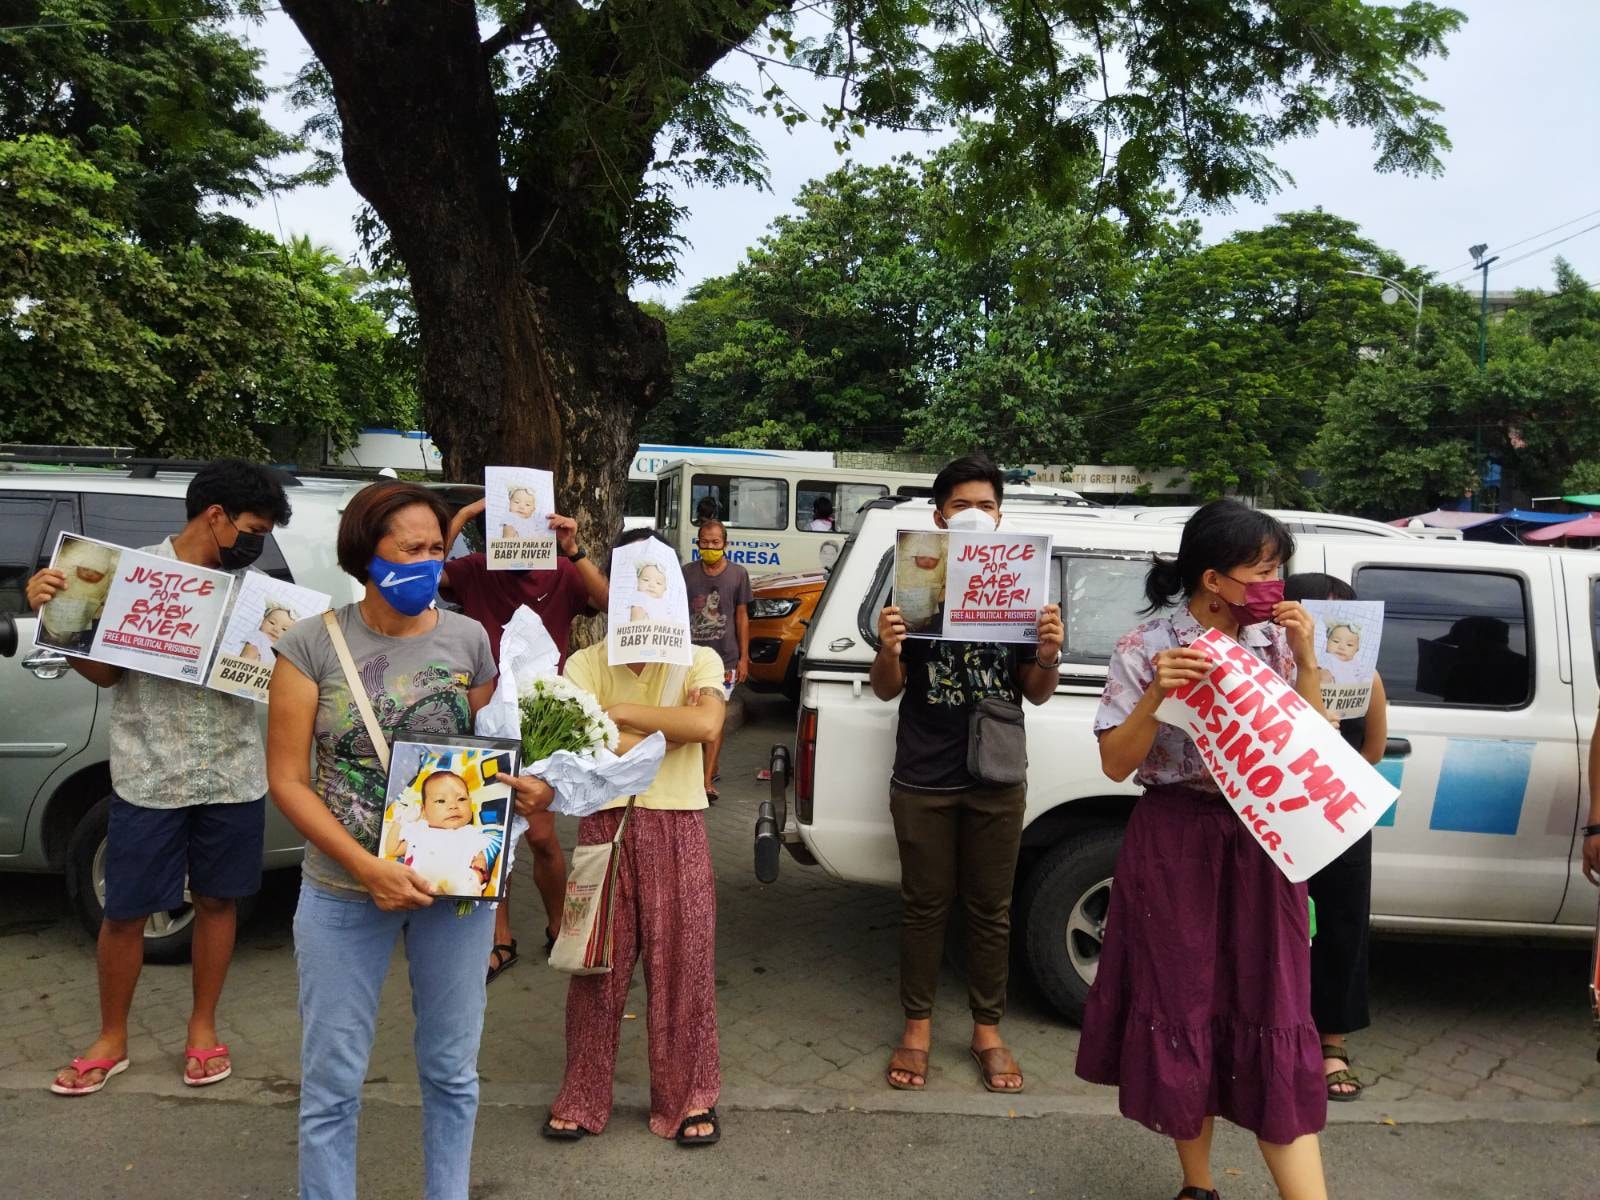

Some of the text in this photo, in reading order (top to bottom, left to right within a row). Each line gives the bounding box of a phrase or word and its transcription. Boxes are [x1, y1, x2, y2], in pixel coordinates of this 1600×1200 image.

[1090, 474, 1117, 484] GREEN
[491, 541, 520, 549] HUSTISYA
[494, 549, 551, 559] BABY RIVER!
[957, 544, 1036, 563] JUSTICE
[982, 561, 1008, 575] FOR
[125, 566, 215, 596] JUSTICE
[968, 572, 1021, 589] BABY
[150, 590, 180, 603] FOR
[961, 588, 1031, 608] RIVER!
[131, 599, 193, 620] BABY
[950, 611, 964, 620] FREE
[965, 611, 975, 620] ALL
[976, 611, 1003, 620] POLITICAL
[616, 624, 685, 636] HUSTISYA PARA KAY
[103, 631, 121, 642] FREE
[119, 633, 132, 644] ALL
[132, 636, 163, 650] POLITICAL
[620, 634, 683, 648] BABY RIVER!
[220, 657, 271, 678] HUSTISYA PA
[1204, 629, 1307, 719] FREE
[220, 668, 253, 684] BABY
[1339, 689, 1356, 698] PARA
[1357, 687, 1370, 696] KAY
[1336, 697, 1366, 710] RIVER!
[1288, 748, 1366, 834] MAE
